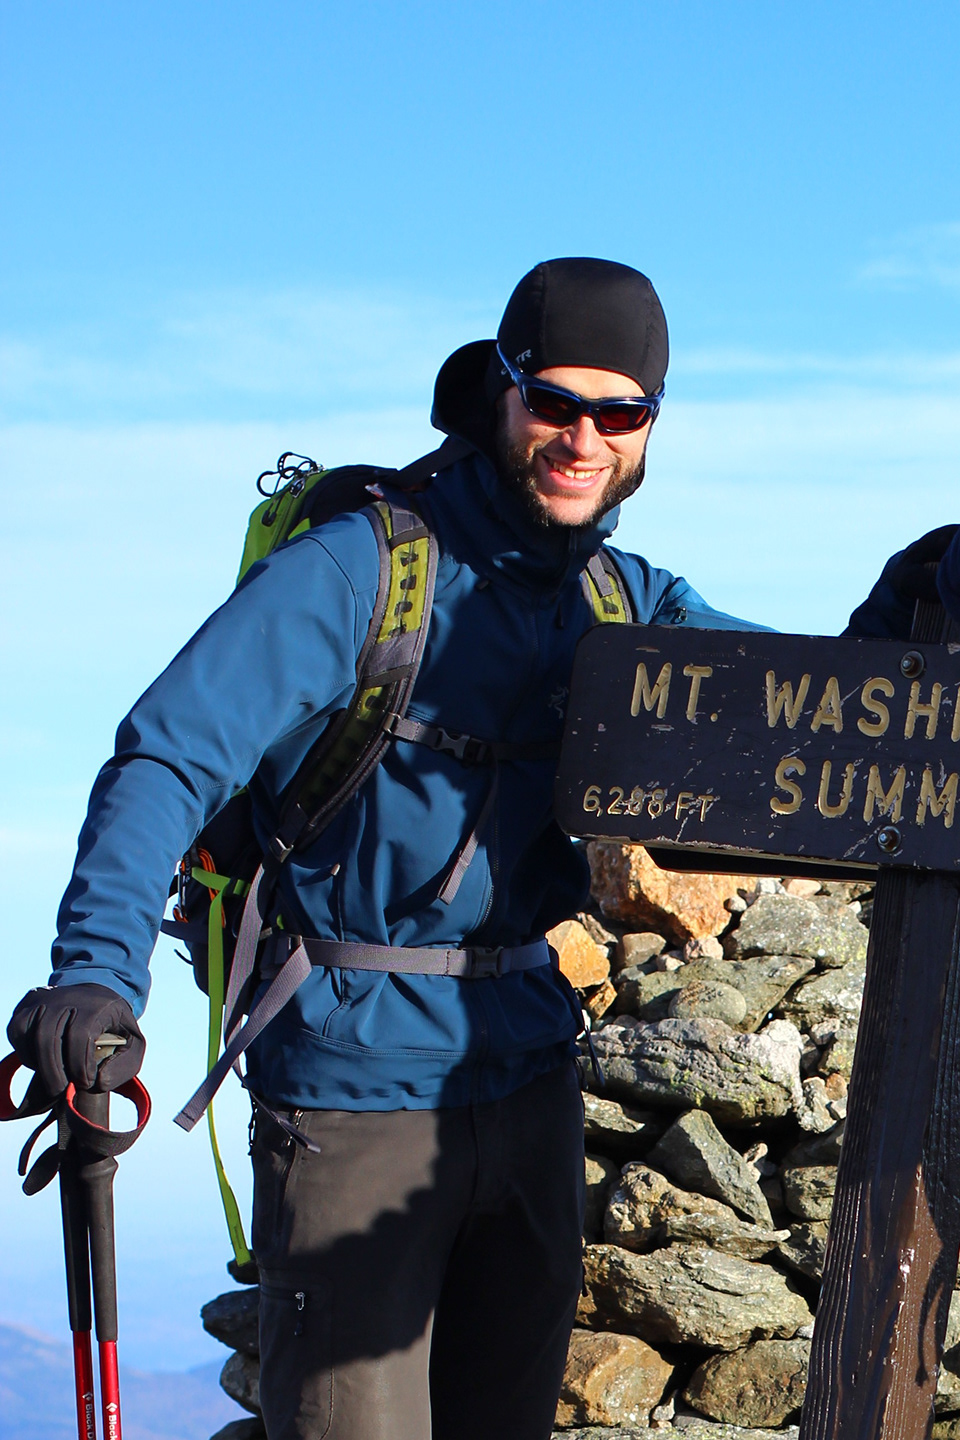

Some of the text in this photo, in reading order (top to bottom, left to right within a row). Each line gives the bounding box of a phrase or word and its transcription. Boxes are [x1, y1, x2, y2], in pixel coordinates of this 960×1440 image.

[630, 662, 719, 723] MT.
[582, 784, 715, 823] 6,288 FT
[85, 1403, 93, 1430] Black
